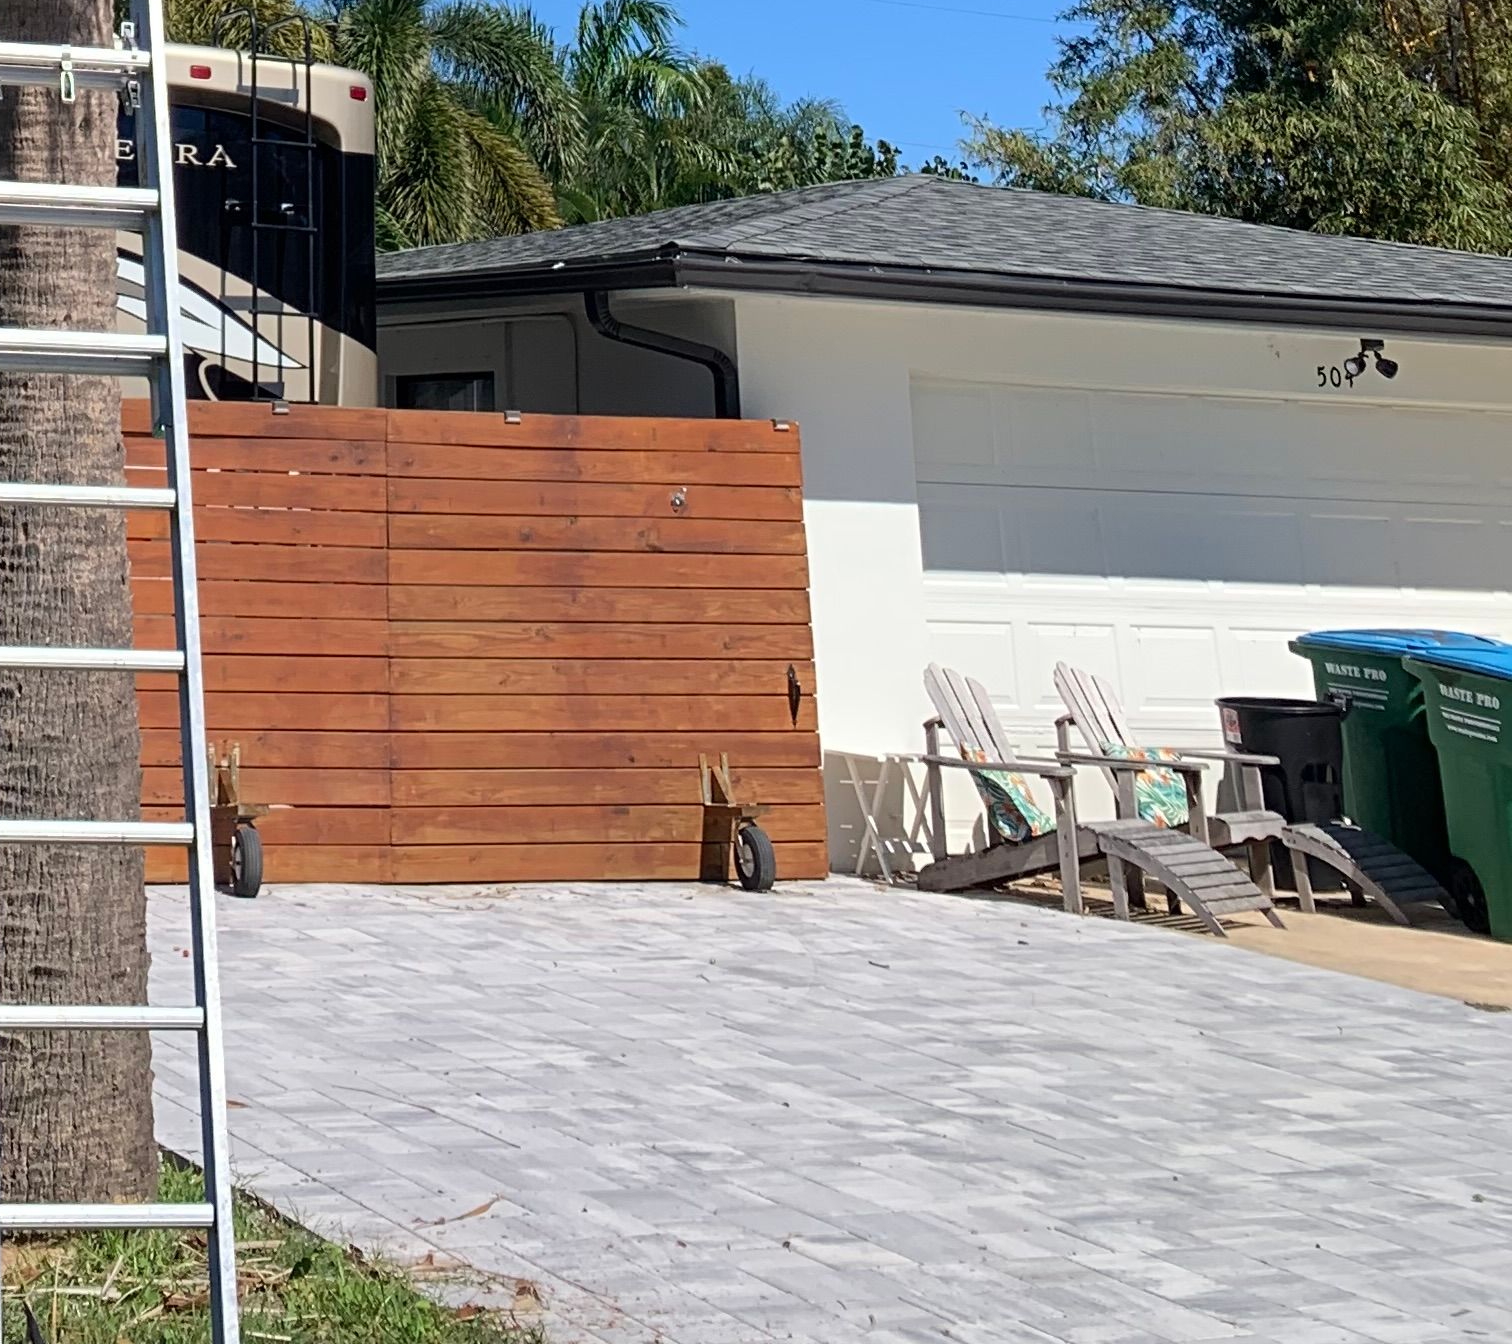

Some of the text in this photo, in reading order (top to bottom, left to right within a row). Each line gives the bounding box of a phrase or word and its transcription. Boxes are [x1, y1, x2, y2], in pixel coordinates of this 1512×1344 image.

[1324, 662, 1387, 682] WASTE PRO
[1439, 683, 1500, 710] WASTE PRO
